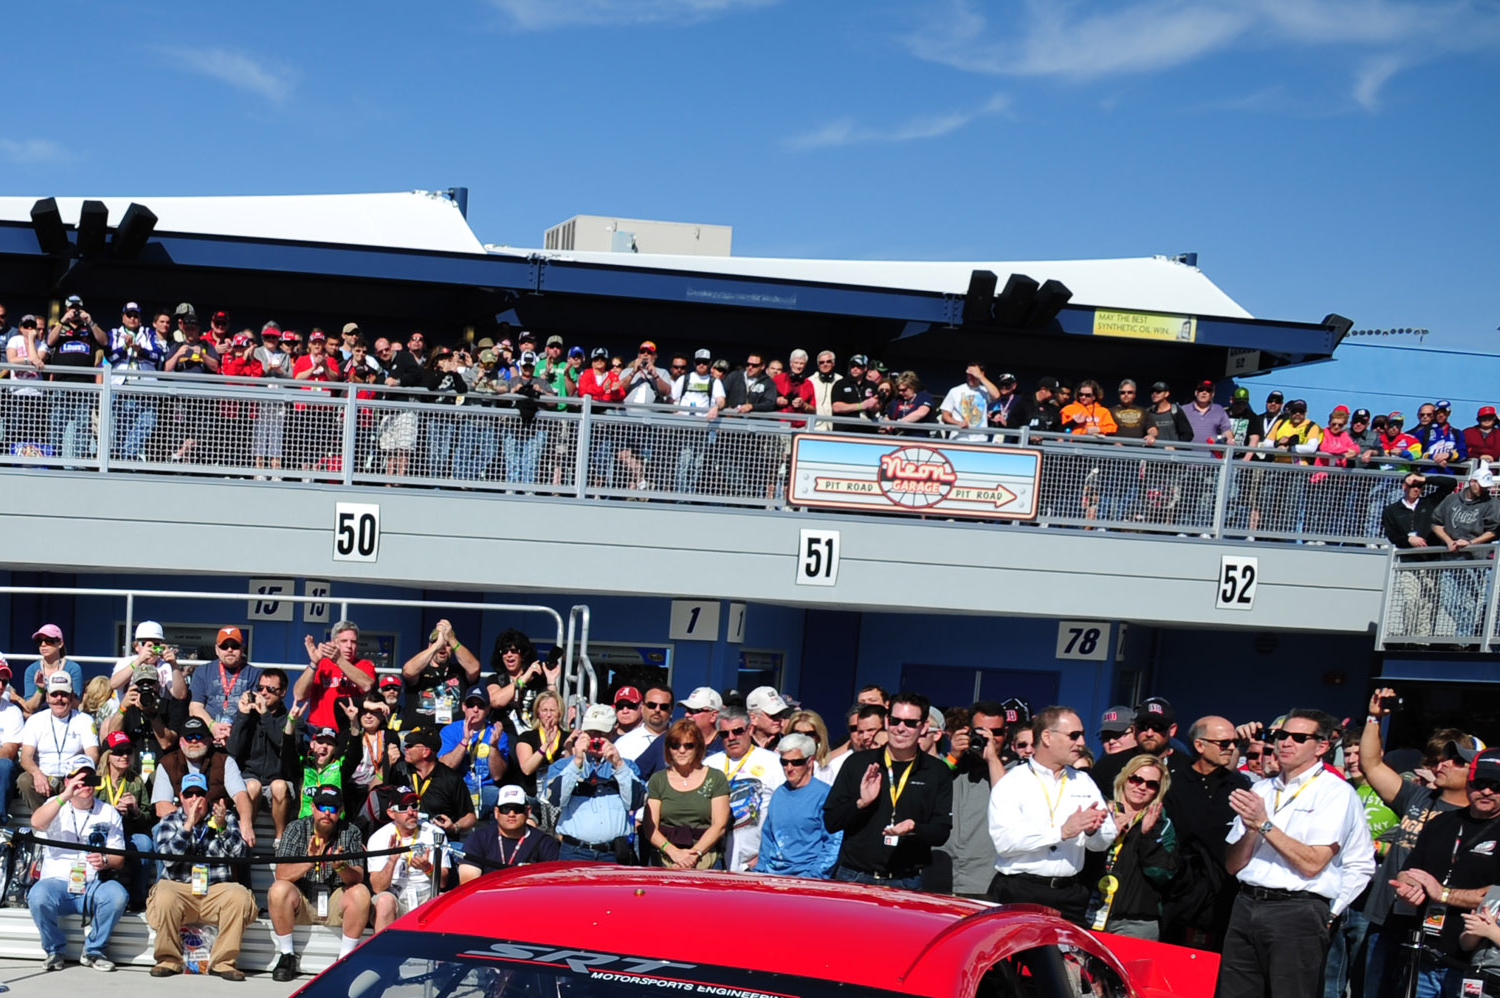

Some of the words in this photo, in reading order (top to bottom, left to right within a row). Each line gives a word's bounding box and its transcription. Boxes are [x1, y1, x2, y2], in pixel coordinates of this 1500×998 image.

[1098, 313, 1114, 322] MAY
[1116, 314, 1130, 323] THE
[1131, 315, 1148, 324] BEST
[1098, 322, 1137, 333] SYNTHETIC
[1139, 324, 1151, 334] OIL
[881, 455, 957, 481] Neon
[825, 481, 844, 491] PIT
[847, 482, 873, 492] ROAD
[892, 480, 941, 493] GARAGE
[955, 489, 974, 499] PIT
[976, 490, 1003, 500] ROAD
[337, 512, 376, 556] 50
[805, 537, 833, 577] 51
[1221, 564, 1255, 604] 52
[255, 586, 283, 615] 15
[309, 587, 327, 616] 15
[686, 606, 702, 634] 1
[736, 610, 744, 637] 1
[1064, 627, 1100, 655] 78
[464, 943, 698, 973] SRT
[591, 971, 694, 991] MOTORSPORTS
